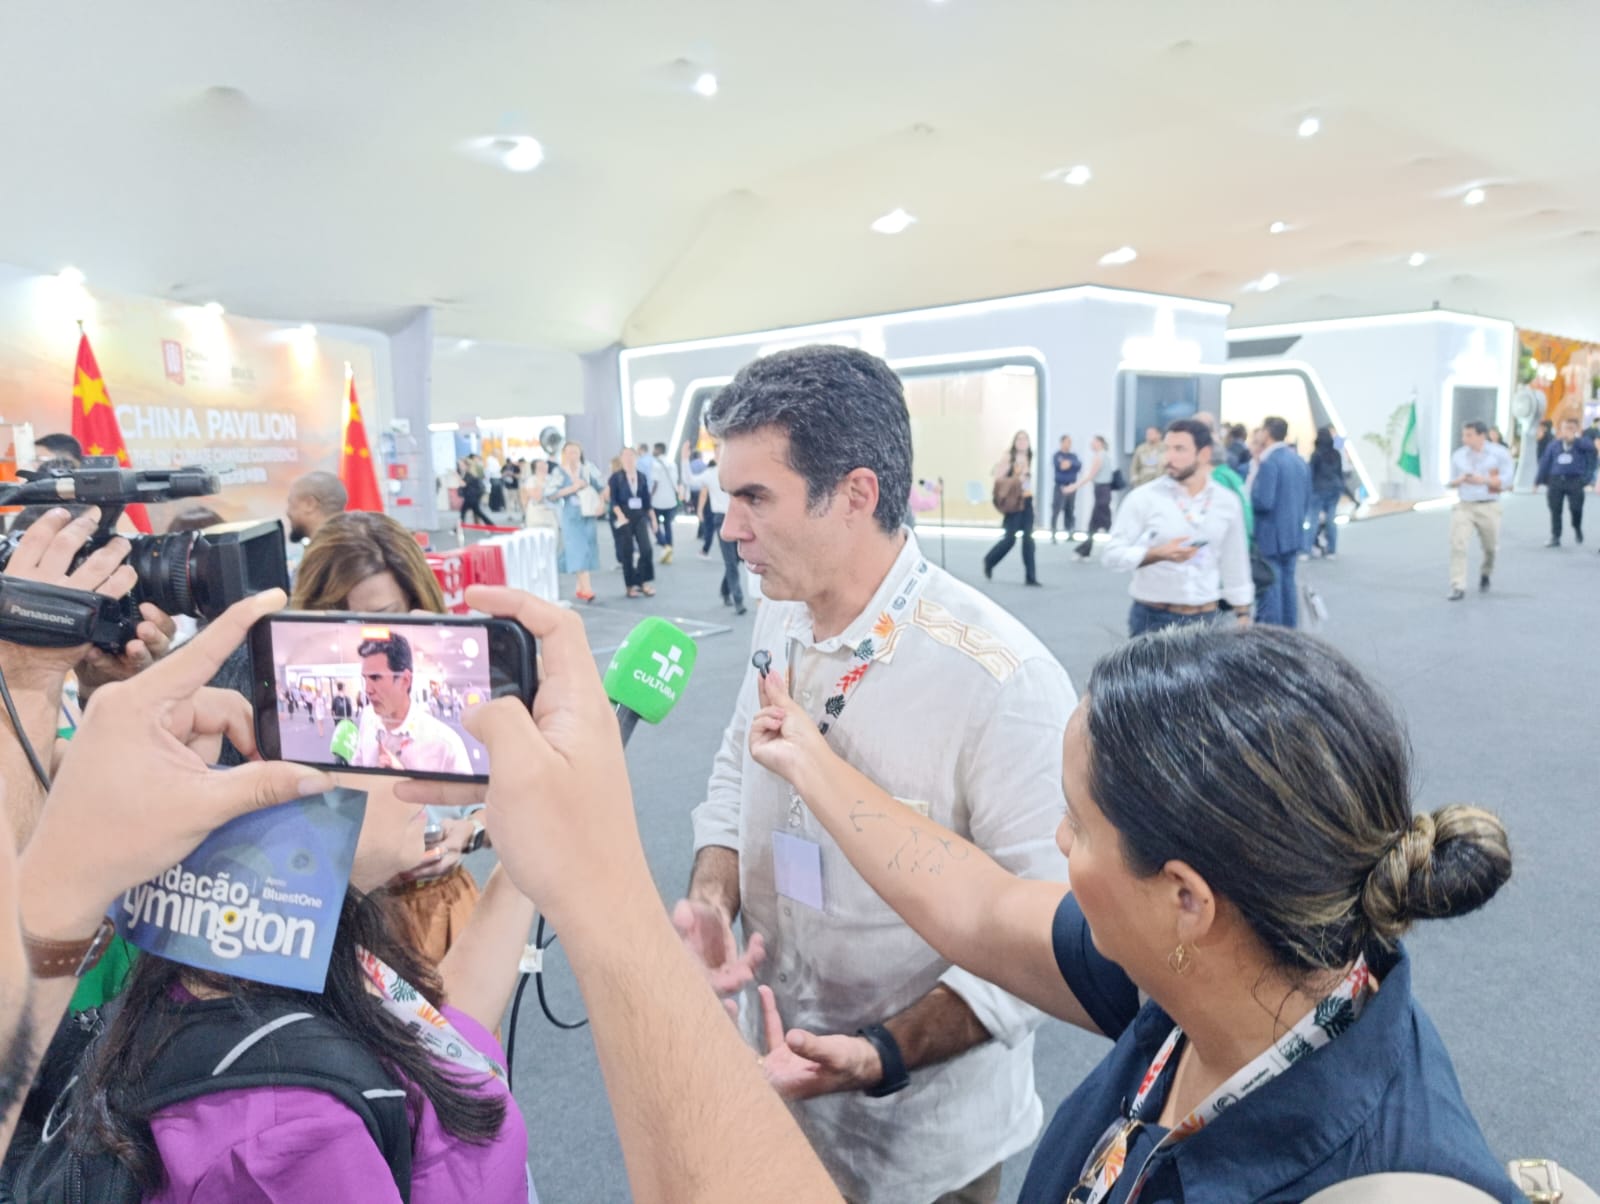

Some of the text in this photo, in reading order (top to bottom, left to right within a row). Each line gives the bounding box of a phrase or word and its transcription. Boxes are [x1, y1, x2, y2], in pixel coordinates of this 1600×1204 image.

[117, 404, 297, 441] CHINA PAVILION
[10, 604, 76, 626] Panasonic
[633, 669, 676, 701] CULTURA
[122, 884, 316, 960] Lymington
